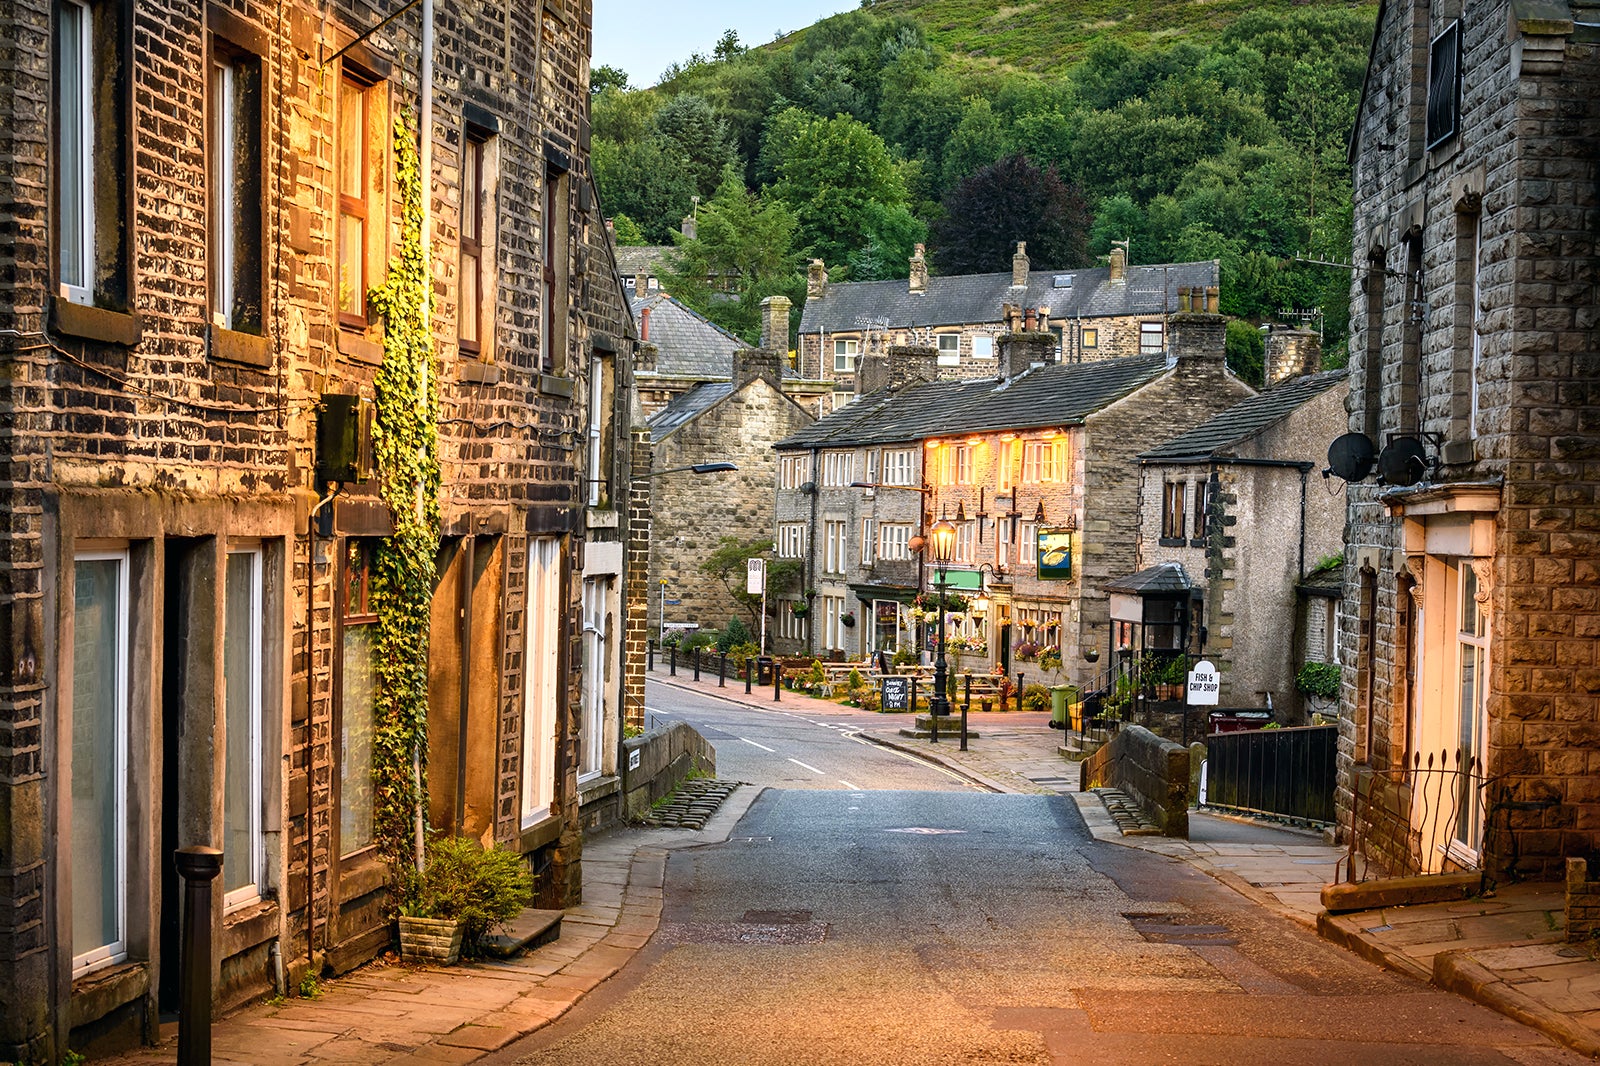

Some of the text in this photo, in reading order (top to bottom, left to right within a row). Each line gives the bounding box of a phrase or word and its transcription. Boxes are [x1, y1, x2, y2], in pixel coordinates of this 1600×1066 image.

[1195, 673, 1213, 682] FISH &
[1190, 682, 1218, 692] CHIP SHOP
